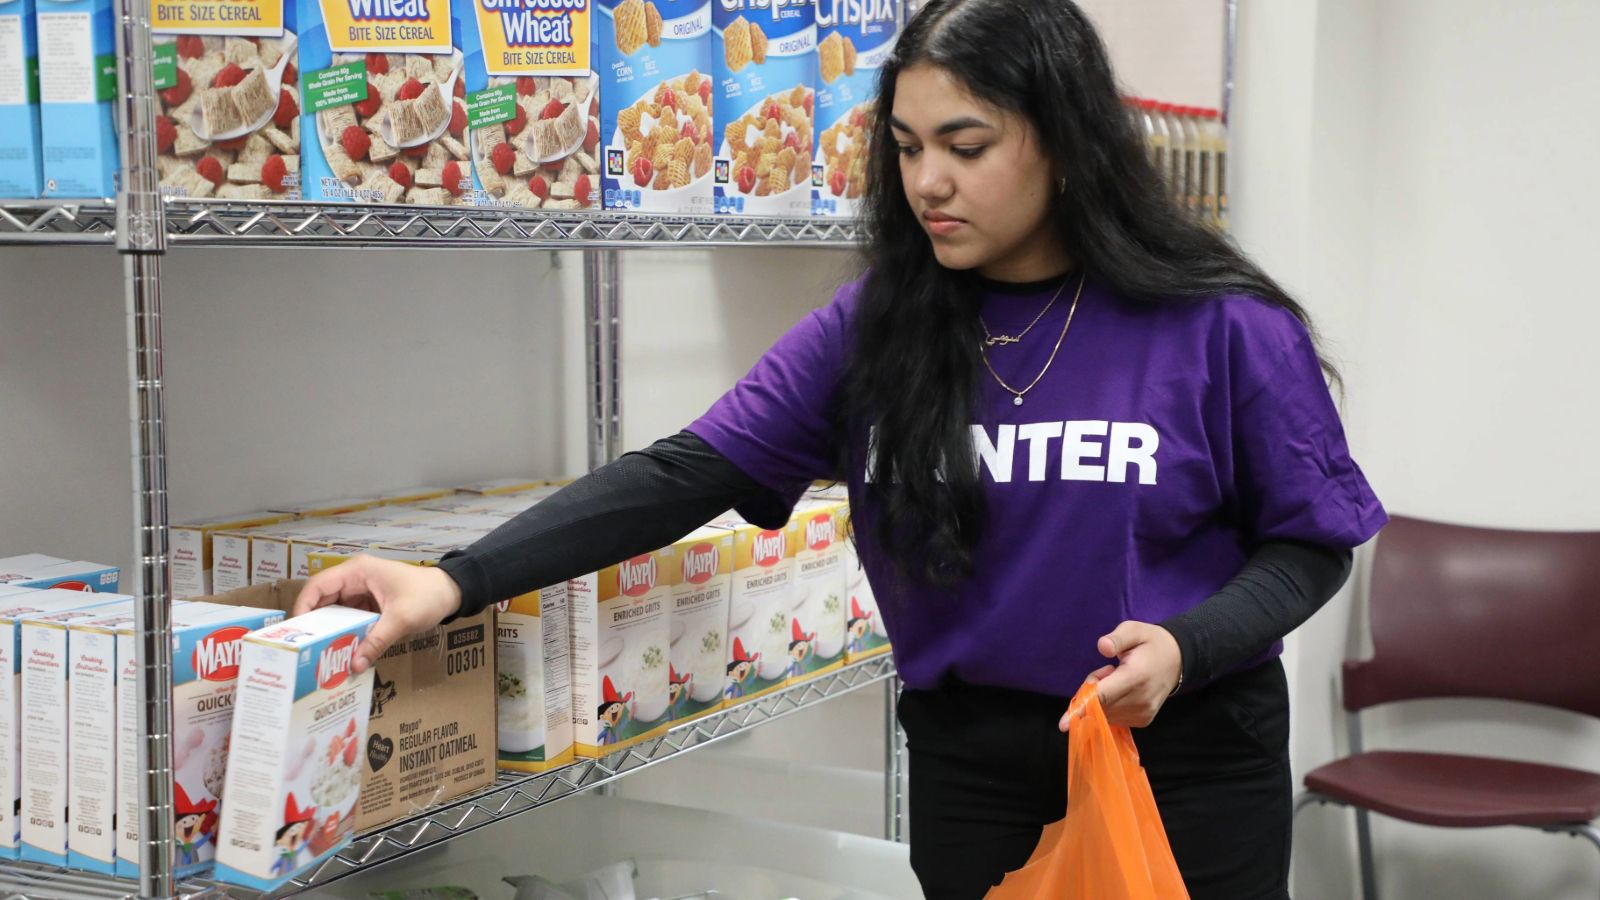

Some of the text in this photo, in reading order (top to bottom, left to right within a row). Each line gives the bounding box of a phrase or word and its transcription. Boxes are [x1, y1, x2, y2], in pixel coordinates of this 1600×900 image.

[157, 5, 262, 21] BITE SIZE CEREAL
[349, 25, 434, 41] BITE SIZE CEREAL
[502, 9, 572, 44] Wheat
[673, 17, 703, 36] ORIGINAL
[779, 34, 811, 53] ORIGINAL
[503, 50, 576, 66] BITE SIZE CEREAL
[616, 66, 633, 77] CORN
[865, 420, 1159, 485] NTER
[806, 516, 836, 549] MAYPO
[754, 531, 785, 566] MAYPO
[683, 544, 718, 583] MAYPO
[619, 556, 656, 596] MAYPO
[747, 575, 773, 590] ENRICHED
[676, 592, 705, 607] ENRICHED
[705, 588, 720, 600] GRITS
[613, 606, 644, 621] ENRICHED
[644, 601, 661, 614] GRITS
[497, 628, 518, 639] RITS
[409, 635, 440, 652] POUCHES
[32, 649, 55, 660] Cooking
[80, 654, 103, 665] Cooking
[196, 638, 243, 681] MAYP
[447, 645, 485, 676] 00301
[254, 667, 282, 681] Cooking
[197, 693, 232, 713] QUICK
[314, 701, 337, 721] QUICK
[338, 691, 356, 710] OATS
[400, 721, 459, 752] REGULAR FLAVOR
[400, 733, 478, 773] INSTANT OATMEAL
